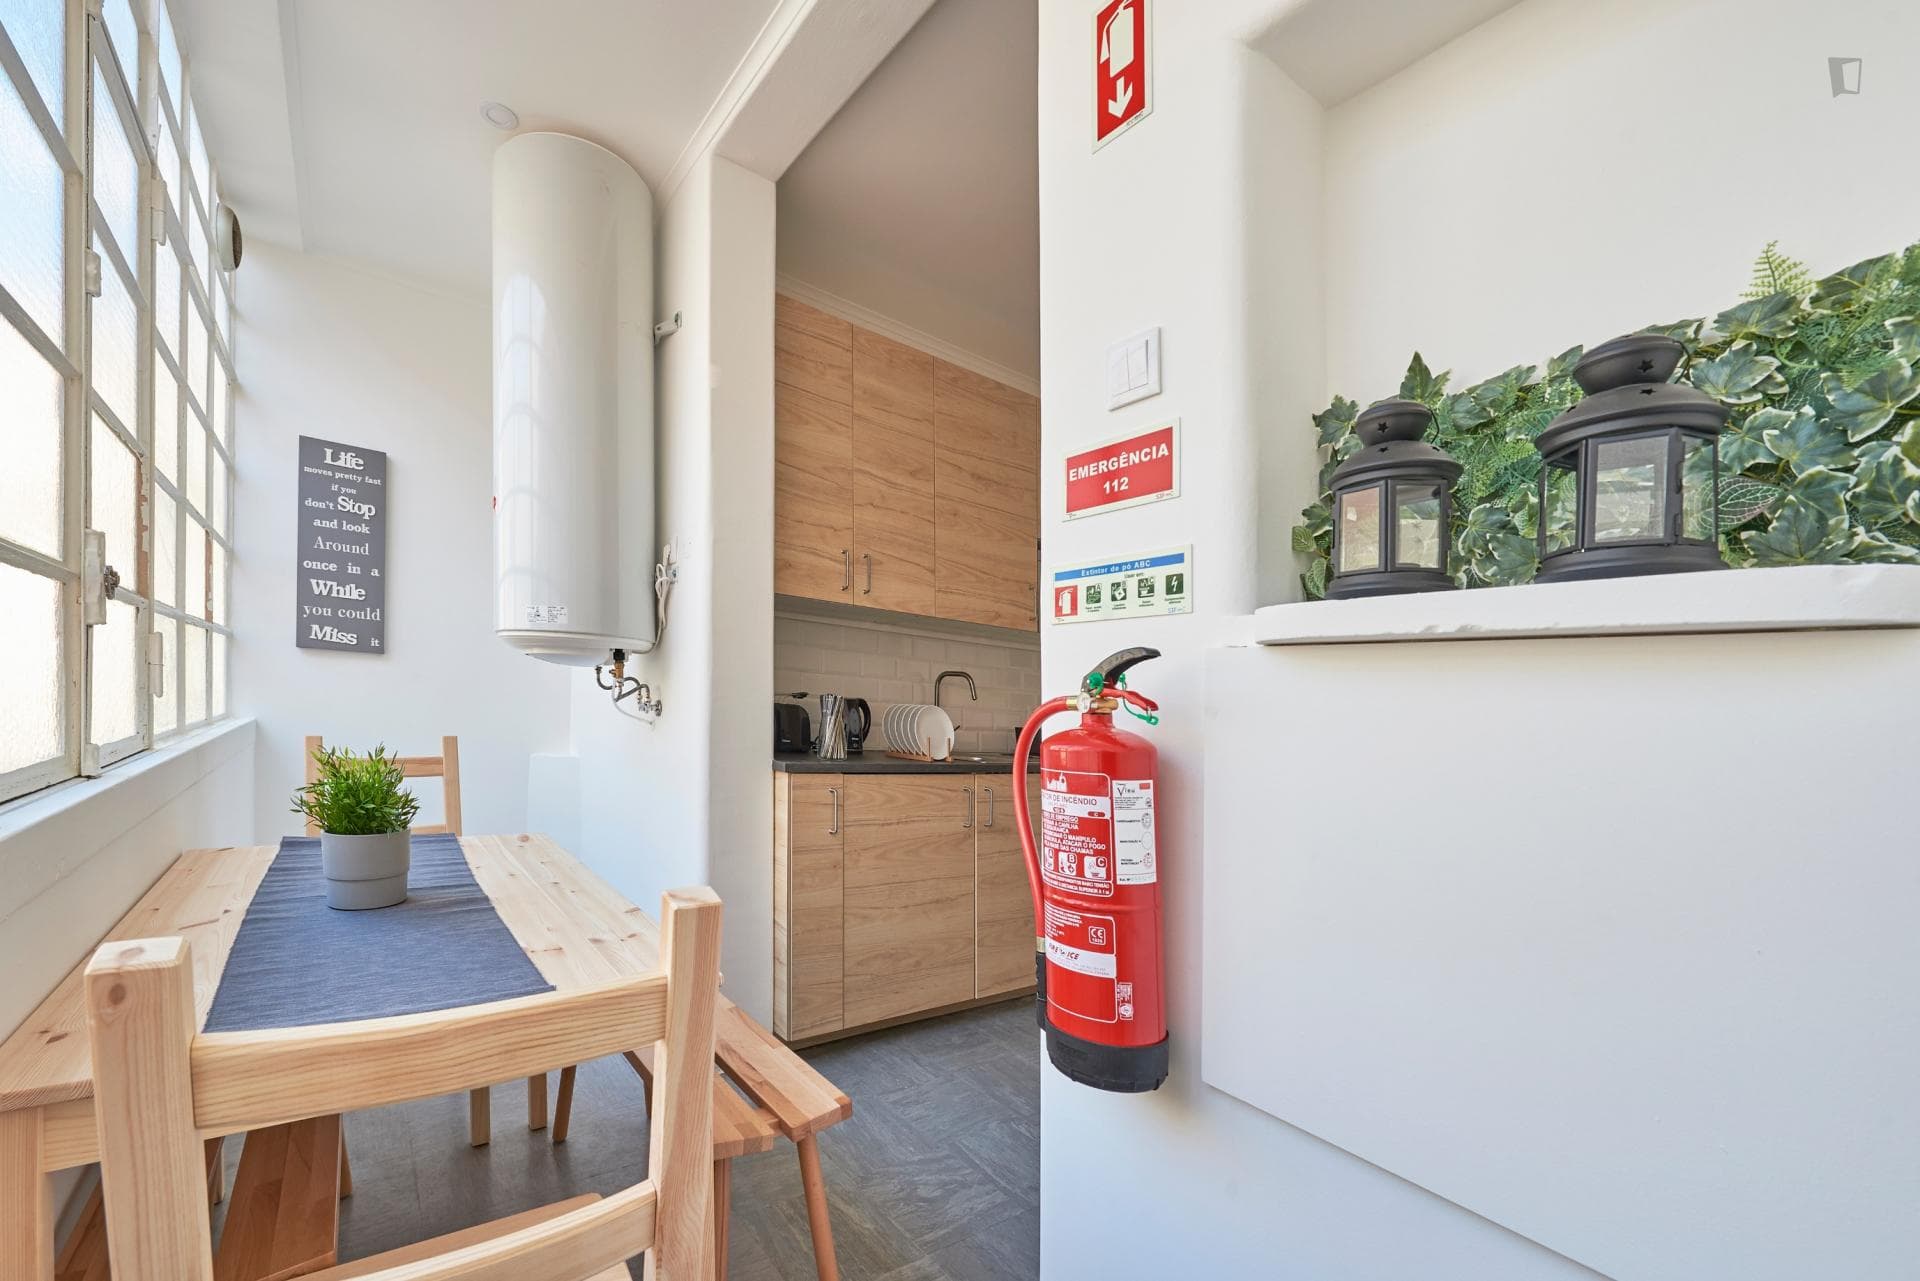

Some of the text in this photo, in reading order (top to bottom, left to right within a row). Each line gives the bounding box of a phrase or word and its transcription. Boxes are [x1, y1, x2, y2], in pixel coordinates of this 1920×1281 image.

[323, 447, 364, 470] Life
[1068, 443, 1169, 482] EMERGÊNCIA
[303, 466, 382, 485] moves pretty fast
[340, 486, 357, 495] you
[1103, 477, 1129, 495] 112
[304, 495, 376, 520] don't Stop
[313, 518, 370, 534] and look
[313, 536, 370, 555] Around
[303, 560, 380, 577] once in a
[1134, 560, 1151, 569] ABC
[310, 578, 366, 601] While
[303, 605, 381, 621] you could
[309, 624, 380, 647] Miss it
[1067, 951, 1080, 960] ICE
